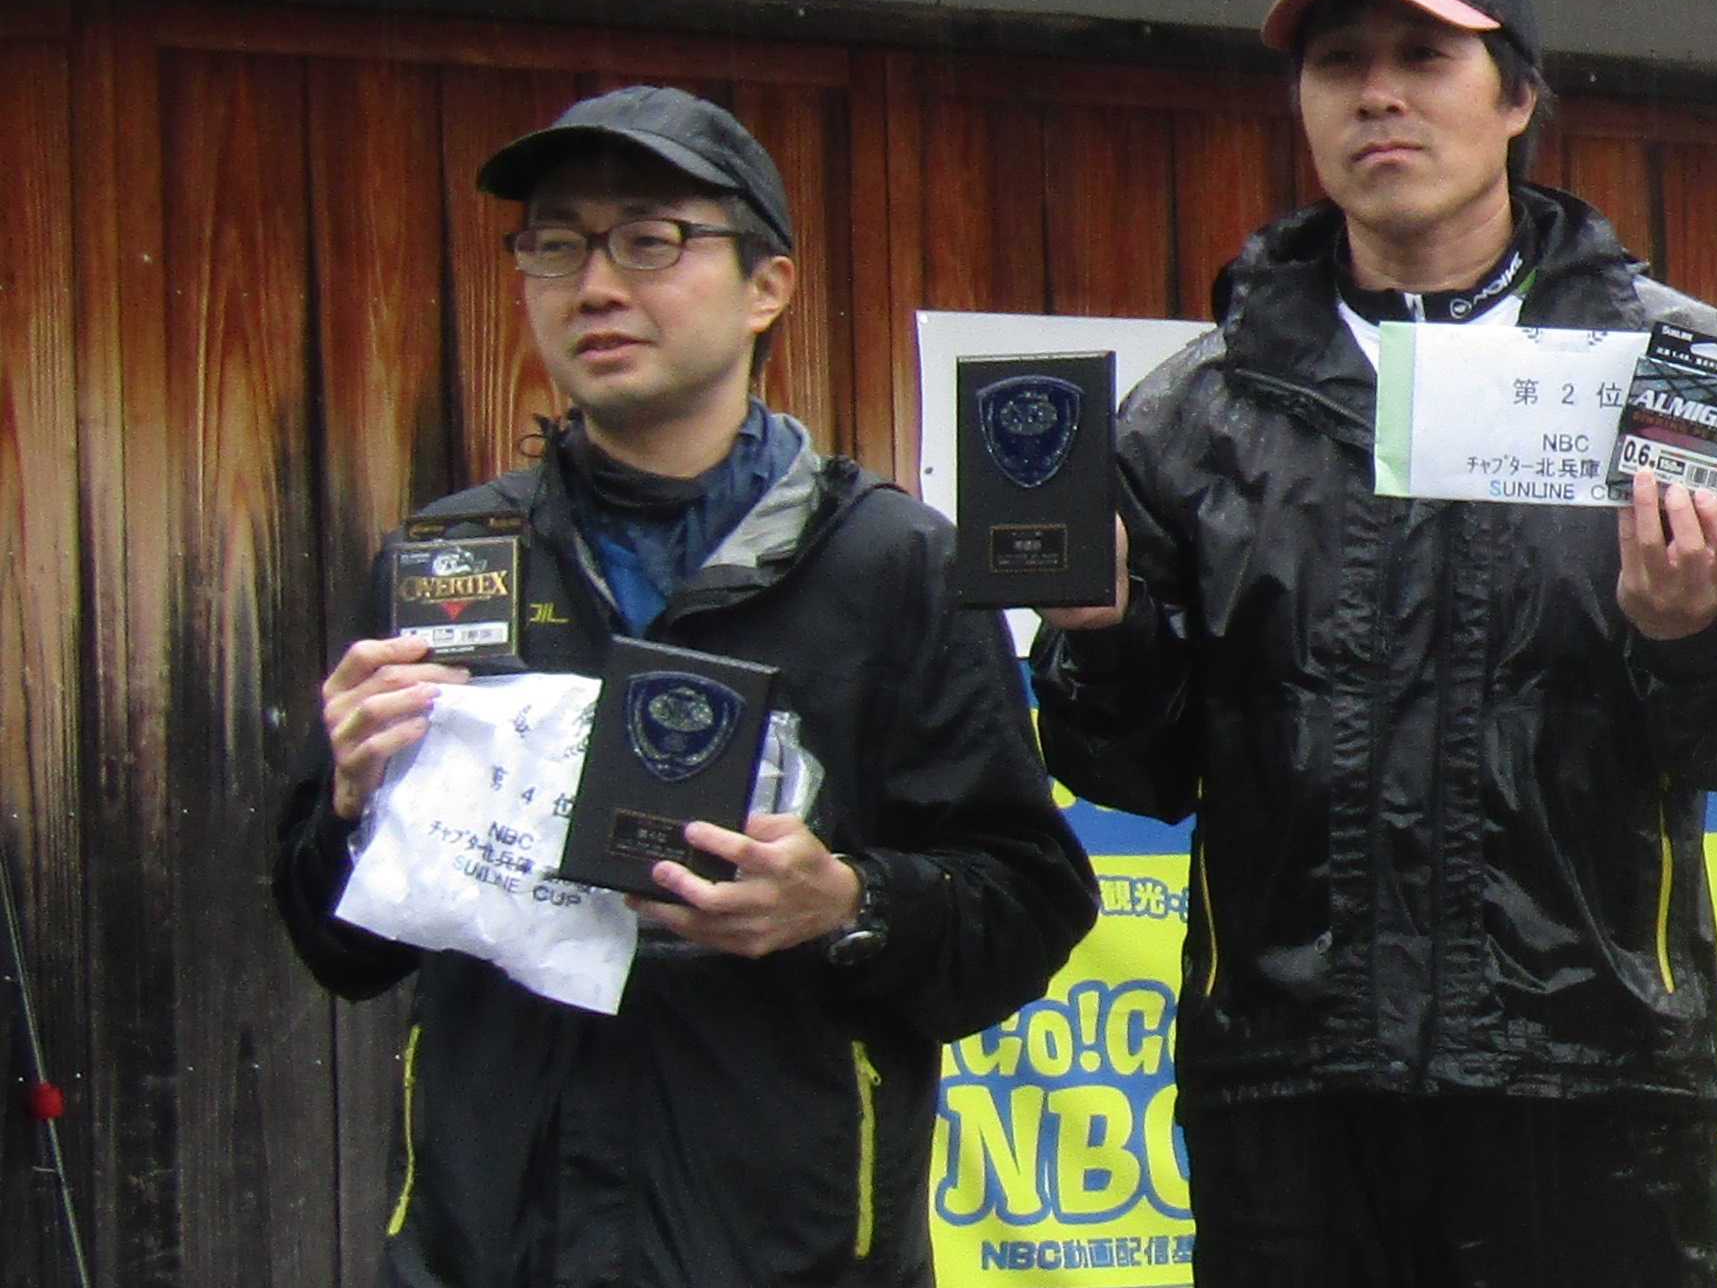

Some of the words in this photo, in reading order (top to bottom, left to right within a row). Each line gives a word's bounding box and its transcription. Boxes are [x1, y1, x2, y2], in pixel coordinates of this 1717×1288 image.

[1543, 434, 1589, 453] NBC
[1489, 480, 1575, 500] SUNLINE
[488, 821, 535, 850] NBC
[532, 883, 581, 907] CUP
